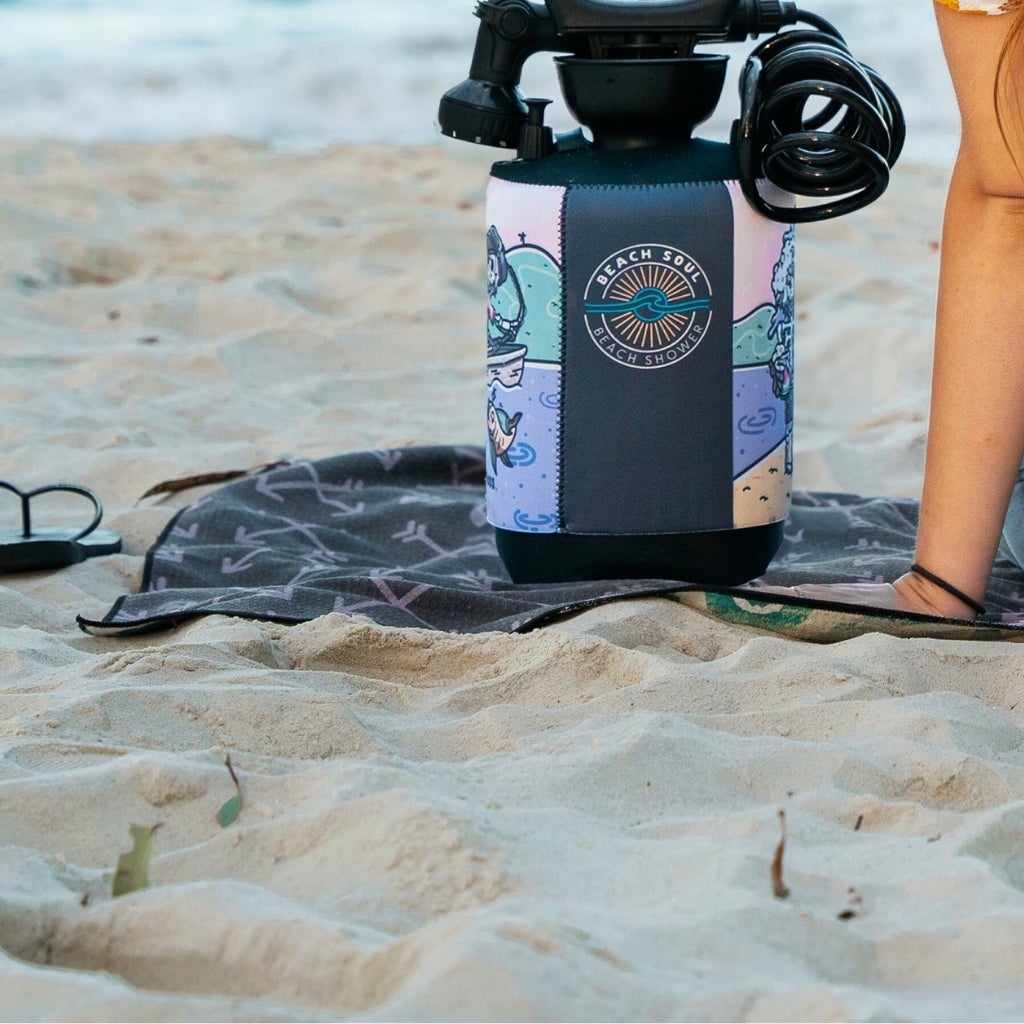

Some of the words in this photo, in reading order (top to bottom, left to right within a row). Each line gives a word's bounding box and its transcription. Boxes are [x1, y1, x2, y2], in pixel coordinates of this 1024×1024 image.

[596, 249, 652, 285] BEACH
[662, 250, 701, 283] SOUL
[593, 327, 637, 364] BEACH
[645, 324, 703, 365] SHOWER
